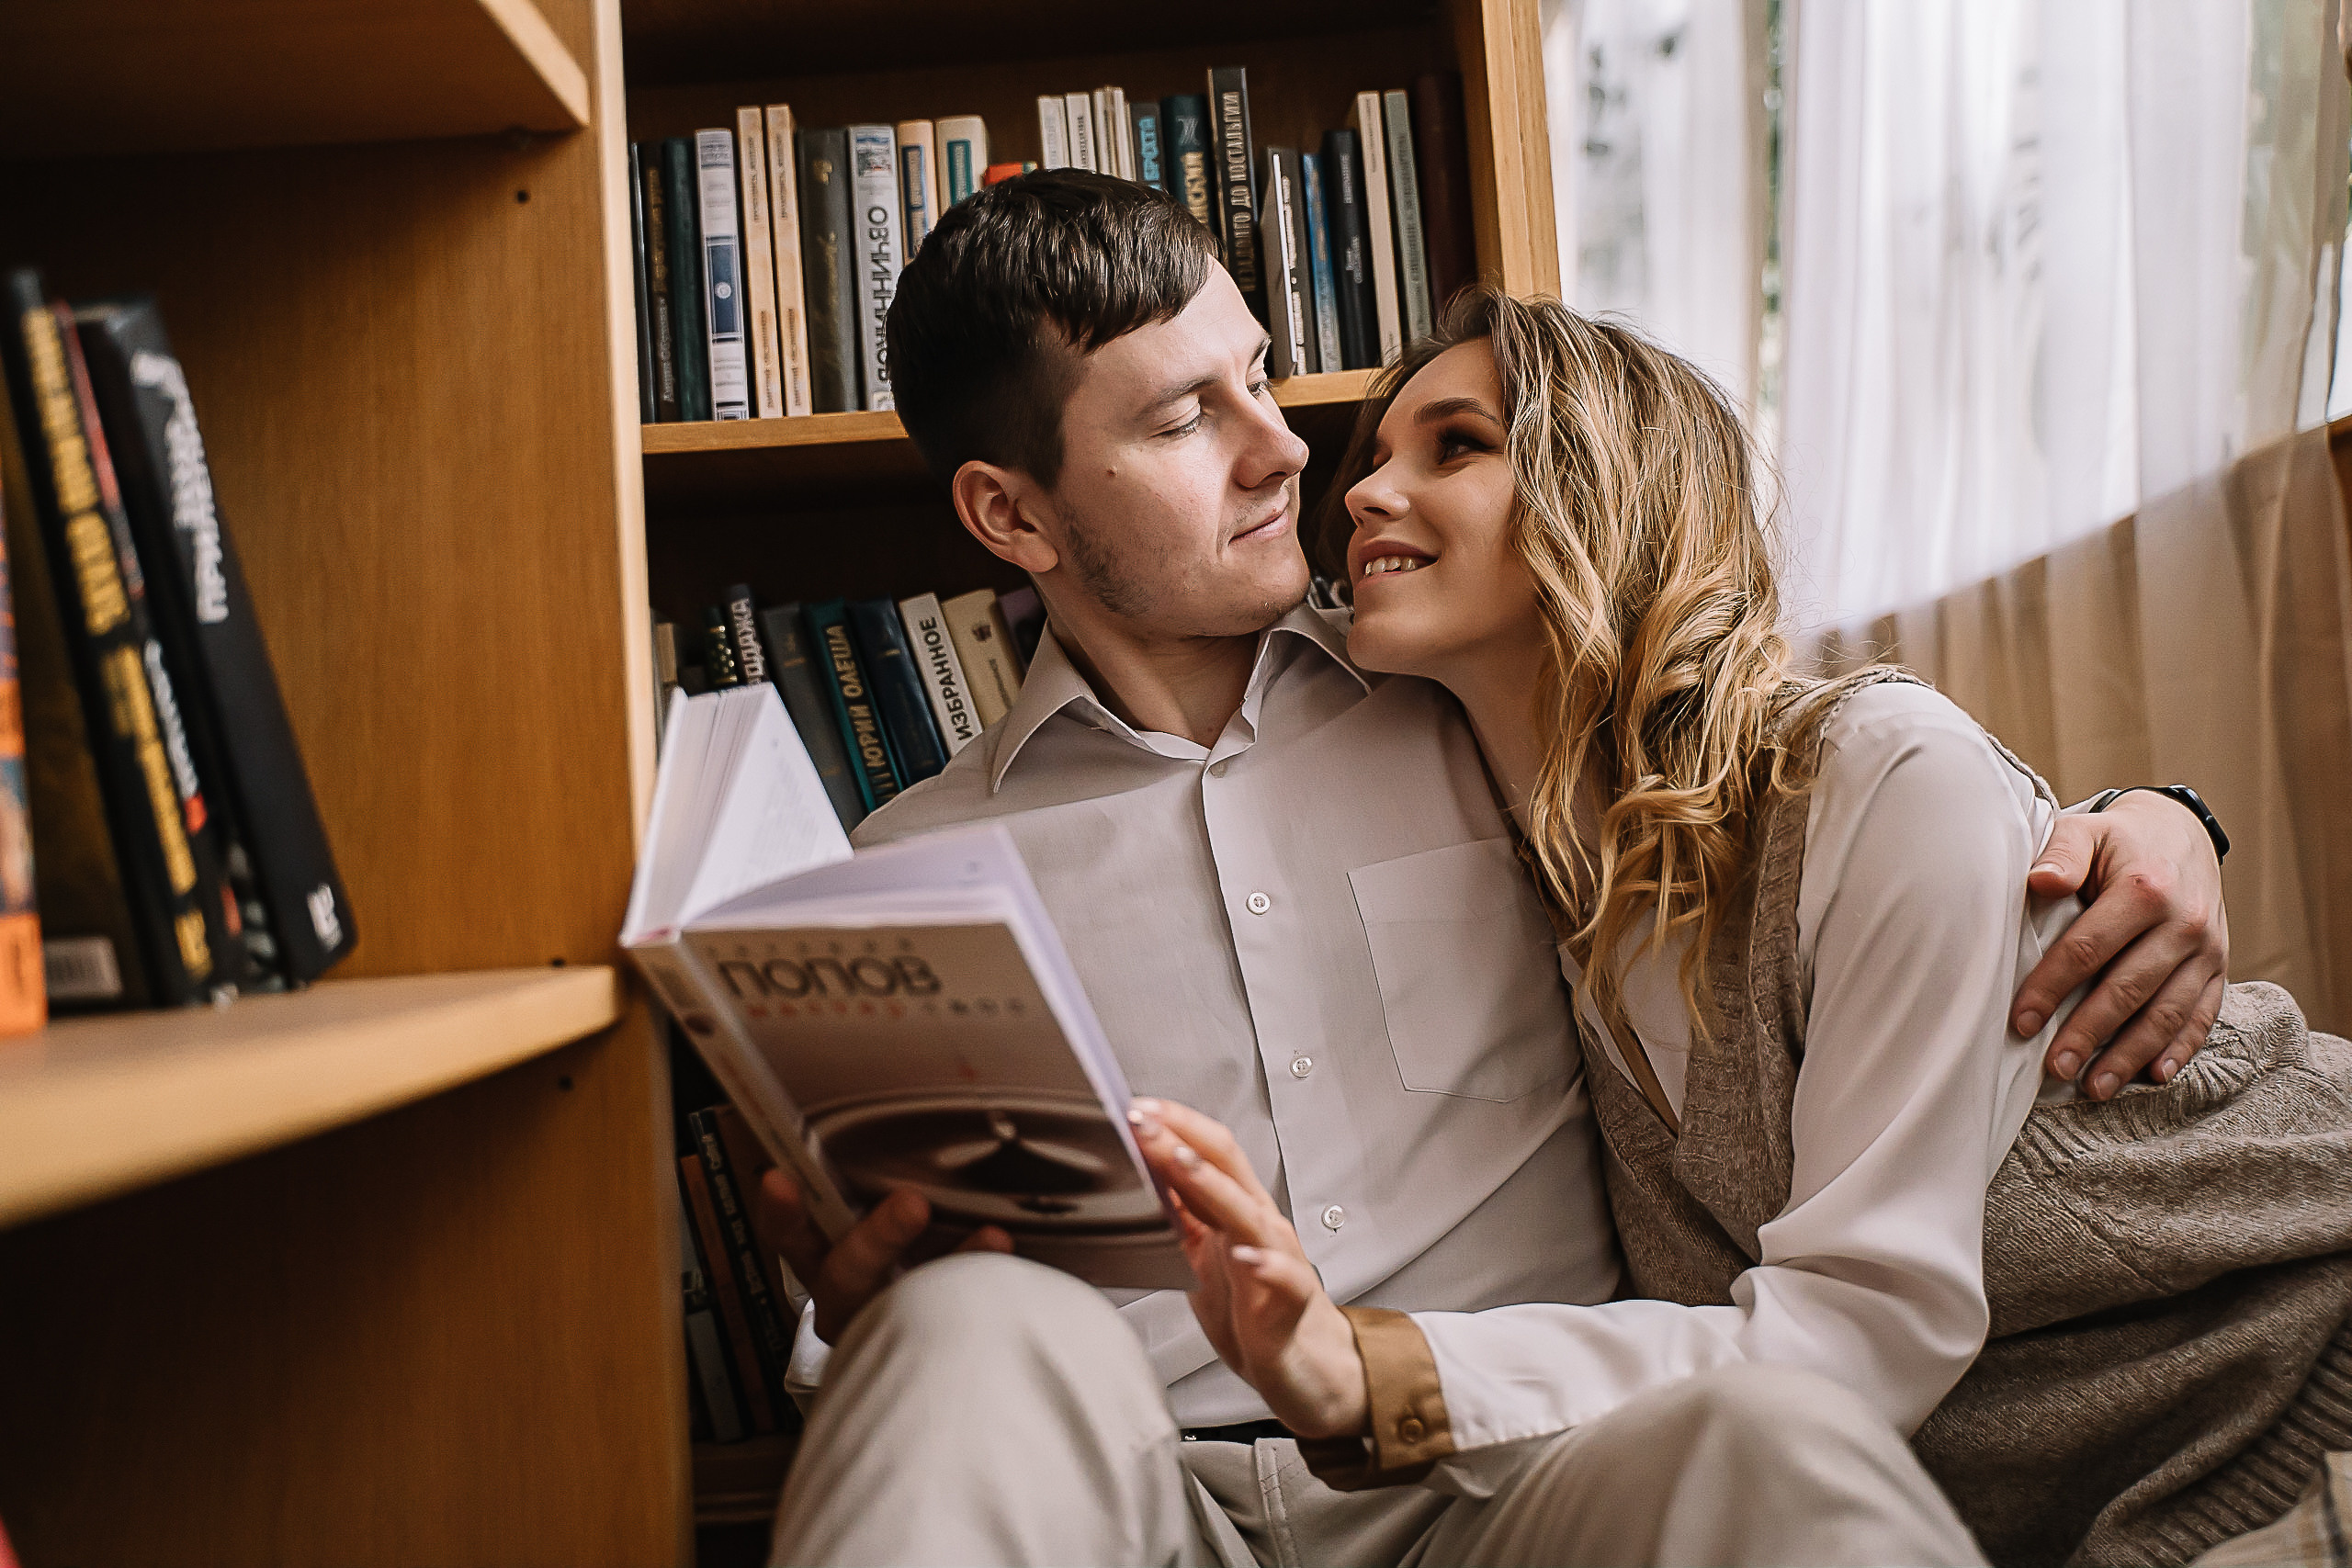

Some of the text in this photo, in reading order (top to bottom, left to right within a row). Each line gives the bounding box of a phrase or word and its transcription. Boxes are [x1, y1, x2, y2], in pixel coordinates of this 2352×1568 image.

[1230, 186, 1251, 209] ДО
[826, 625, 865, 699] ОЛЕША
[919, 615, 974, 742] ИЗБРАННОЕ
[719, 957, 941, 998] ПОПОВ
